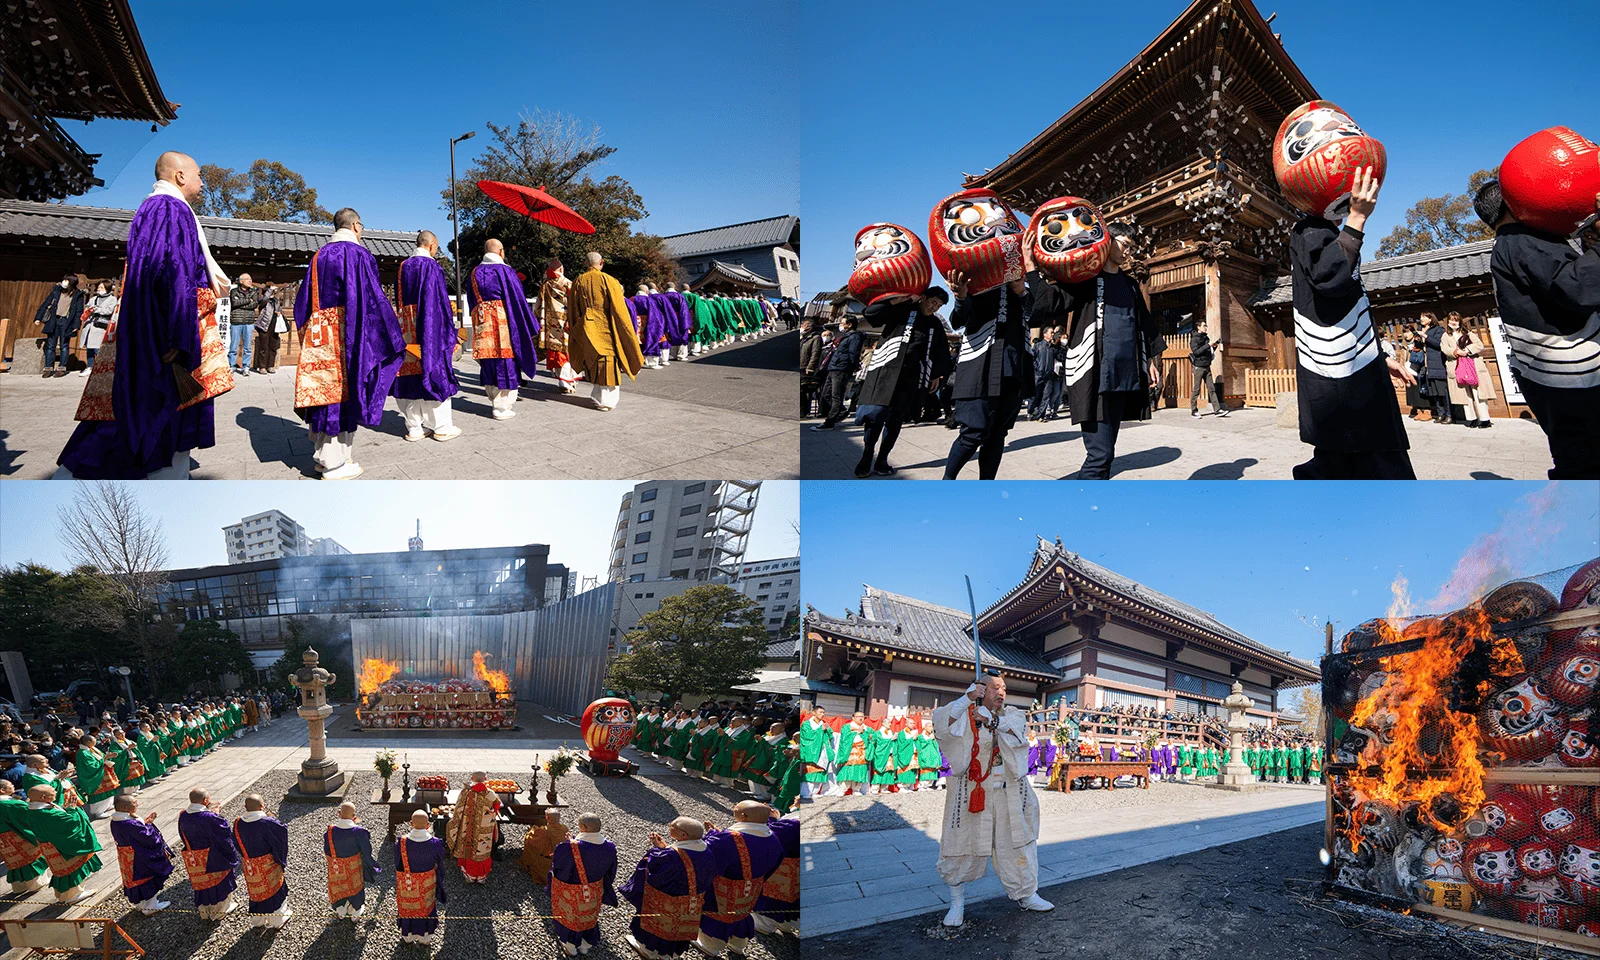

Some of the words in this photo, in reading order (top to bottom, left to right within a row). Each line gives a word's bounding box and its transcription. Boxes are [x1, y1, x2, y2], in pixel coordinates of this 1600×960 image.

[219, 299, 229, 347] 車・駐輪禁
